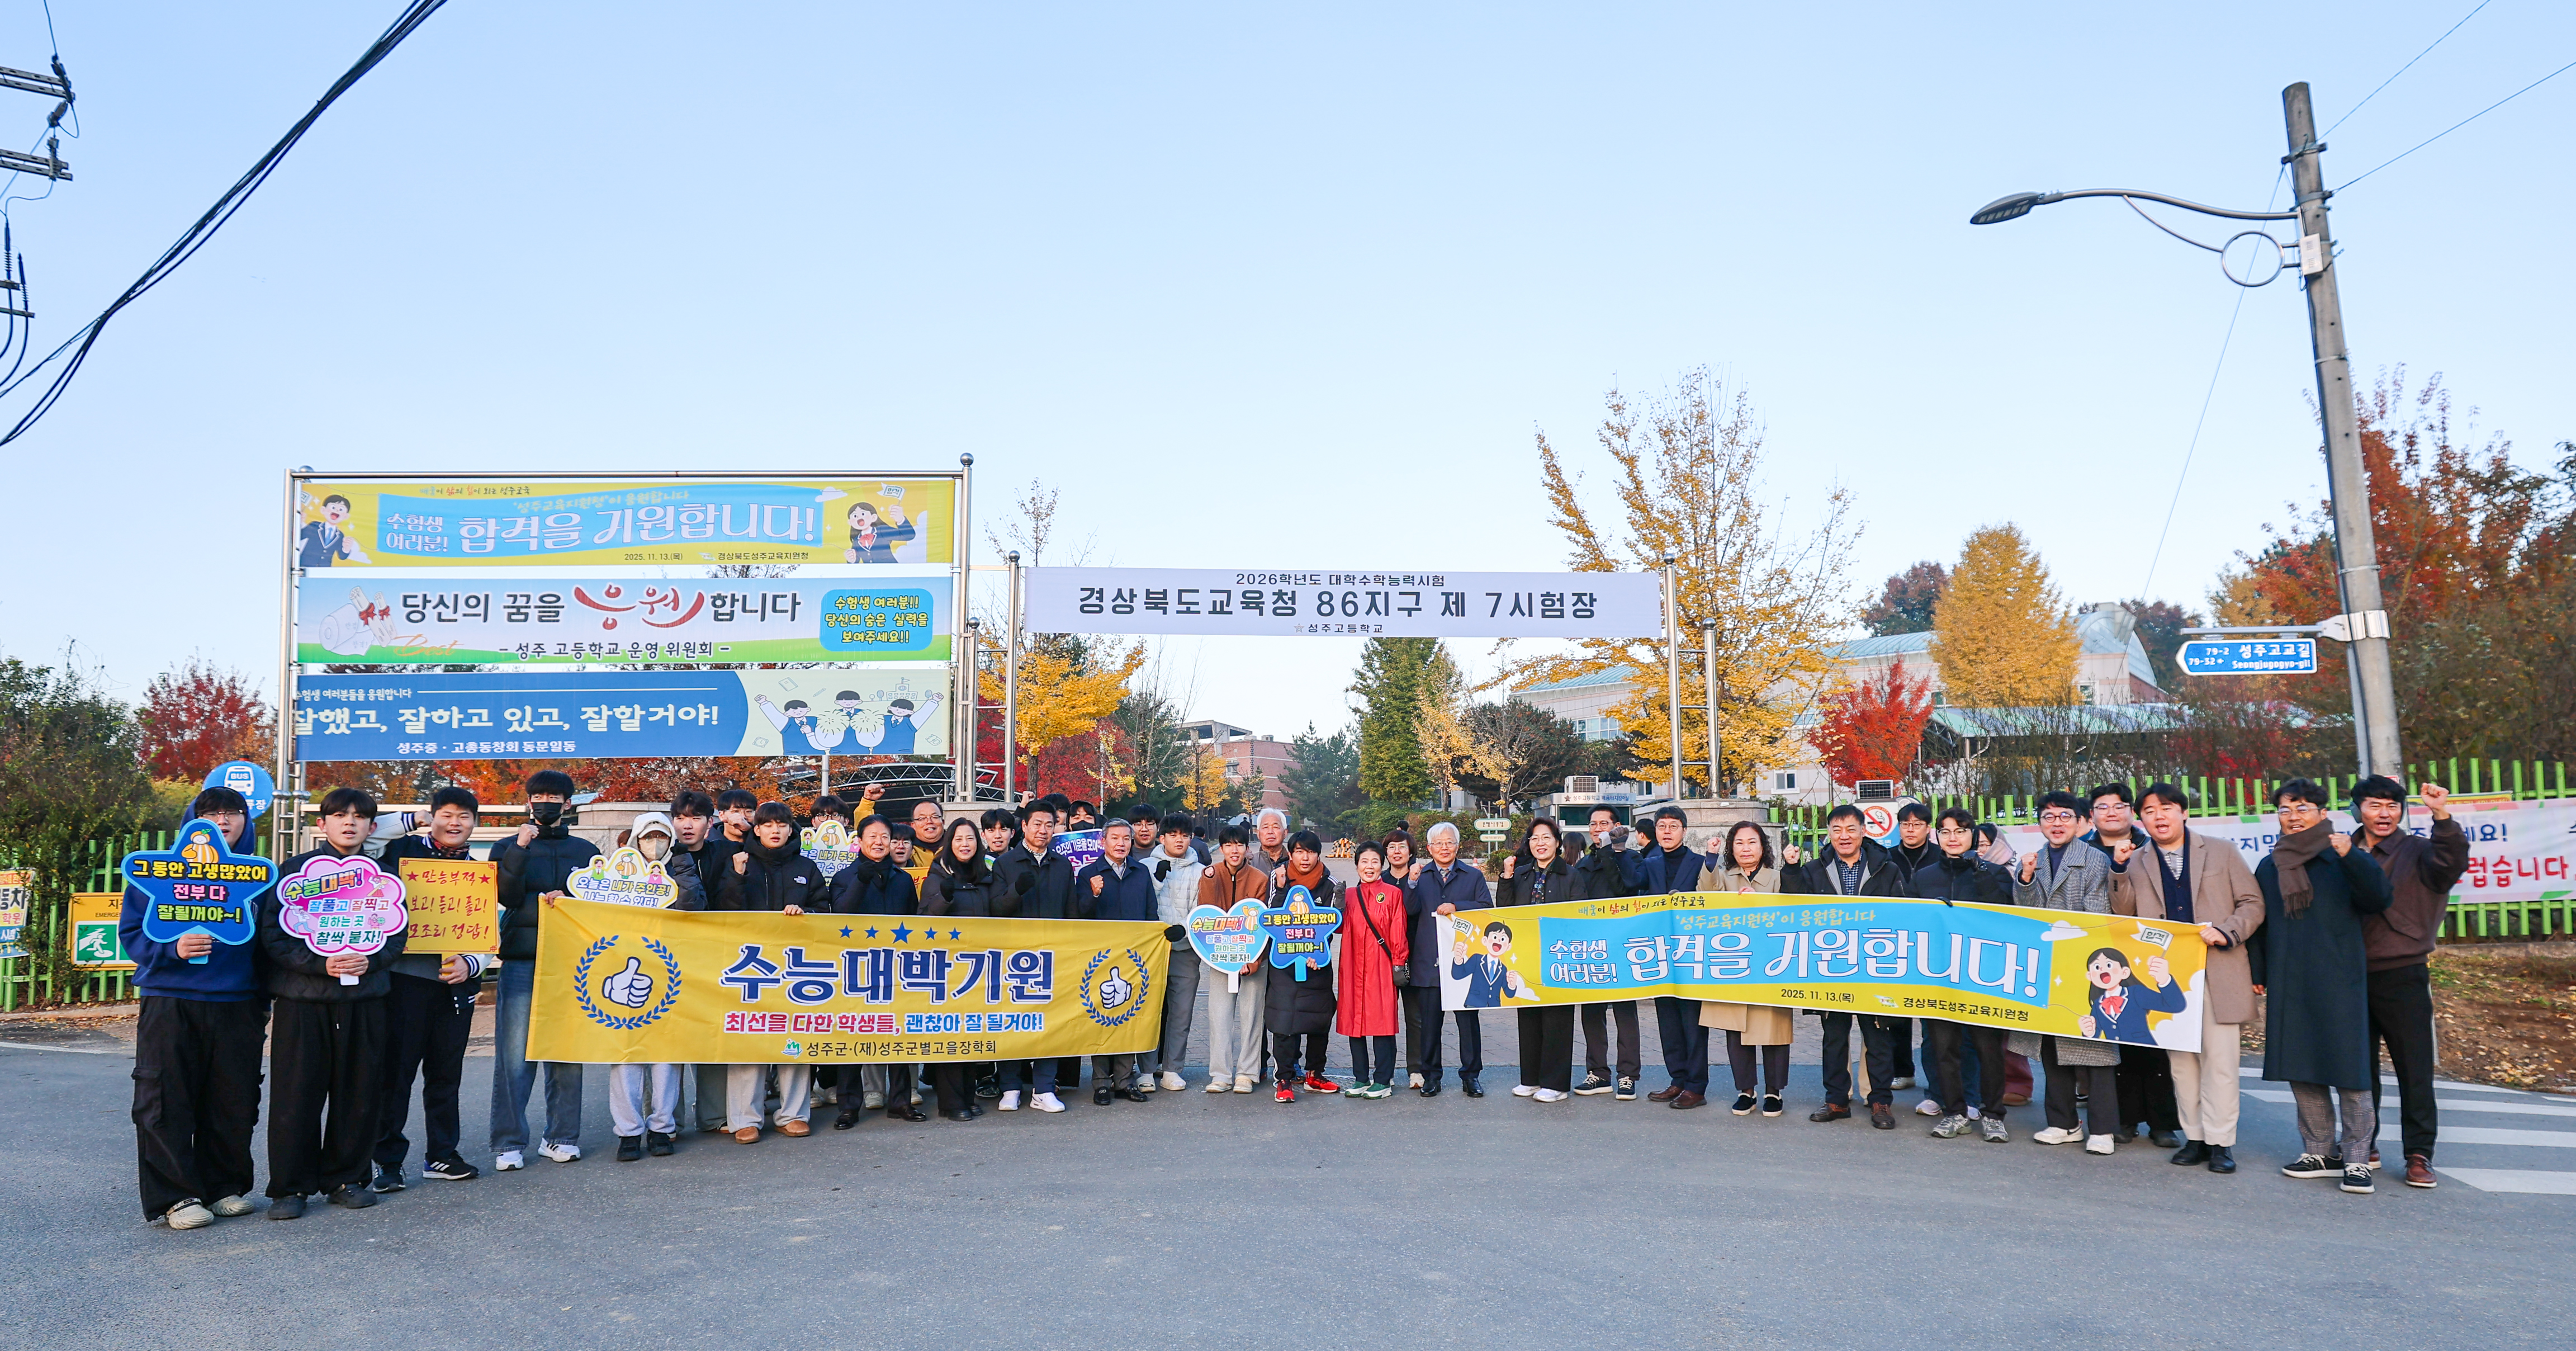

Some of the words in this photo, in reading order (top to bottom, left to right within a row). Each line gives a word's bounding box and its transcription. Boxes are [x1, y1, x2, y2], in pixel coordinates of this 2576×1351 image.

[500, 485, 531, 495] 성주교육
[887, 487, 900, 495] 합격
[625, 490, 689, 506] 응원합니다
[386, 513, 443, 533] 수험생
[457, 512, 584, 553] 합격을
[593, 502, 815, 545] 기원합니다!
[385, 532, 448, 552] 여러분!
[659, 553, 683, 561] 13.(목)
[717, 551, 808, 560] 경상북도성주교육지원청
[1235, 573, 1322, 586] 2026학년도
[1329, 574, 1445, 587] 대학수학능력시험
[402, 593, 490, 623] 당신의
[502, 593, 565, 623] 꿈을
[835, 596, 870, 610] 수험생
[873, 595, 919, 610] 여러분!!
[1079, 587, 1297, 617] 경상북도교육청
[1317, 591, 1422, 617] 86지구
[1441, 592, 1466, 617] 제
[825, 613, 861, 627] 당신의
[864, 613, 886, 627] 숨은
[893, 612, 928, 627] 실력을
[1308, 623, 1384, 634] 성주고등학교
[393, 634, 465, 656] Best
[841, 631, 910, 644] 보여주세요!!
[515, 643, 546, 659] 성주
[553, 642, 621, 659] 고등학교
[628, 642, 659, 658] 운영
[666, 641, 713, 658] 위원회
[2206, 647, 2230, 656] 79-2
[2239, 643, 2311, 659] 성주고교길
[2231, 659, 2311, 670] Seongjugogyo-gil
[322, 688, 366, 701] 여러분들을
[367, 688, 411, 701] 응원합니다
[295, 707, 388, 735] 잘했고,
[396, 706, 493, 734] 잘하고
[504, 705, 570, 733] 있고,
[579, 703, 718, 732] 잘할거야!
[396, 742, 438, 754] 성주중
[451, 741, 519, 754] 고총동창회
[522, 740, 576, 753] 동문일동
[247, 799, 267, 810] 류장
[819, 849, 837, 861] 내가
[839, 851, 859, 862] 주인
[133, 860, 149, 876] 그
[153, 861, 184, 877] 동안
[188, 862, 267, 881] 고생많았어
[284, 867, 363, 901] 수능대박!
[422, 871, 476, 886] 만능부적
[576, 876, 610, 891] 오늘은
[612, 880, 634, 892] 내가
[635, 882, 671, 896] 주인공!
[0, 887, 25, 910] 동차
[173, 884, 206, 900] 전부
[210, 885, 226, 901] 다
[308, 899, 348, 913] 잘풀고
[352, 898, 389, 911] 잘찍고
[410, 897, 433, 913] 보고!
[1578, 904, 1606, 917] 배움이
[1609, 902, 1629, 914] 삶의
[1632, 899, 1650, 913] 힘이
[1670, 895, 1706, 909] 성주교육
[158, 905, 241, 923] 잘될꺼야~!
[319, 916, 352, 928] 원하는
[354, 915, 364, 927] 곳
[1263, 915, 1272, 925] 그
[1273, 915, 1291, 925] 동안
[1292, 913, 1337, 924] 고생많았어
[1799, 908, 1876, 927] 응원합니다
[1191, 917, 1244, 932] 수능대박!
[1455, 920, 1470, 932] 합격
[316, 932, 347, 946] 찰싹
[350, 930, 381, 944] 붙자!
[408, 924, 446, 939] 모조리
[451, 925, 489, 941] 정답!
[1206, 934, 1230, 943] 잘풀고
[1232, 935, 1254, 943] 잘찍고
[1286, 928, 1304, 938] 전부
[1305, 928, 1315, 938] 다
[2145, 928, 2166, 943] 합격
[1215, 944, 1237, 953] 원하는
[1239, 944, 1246, 952] 곳
[1549, 938, 1608, 960] 수험생
[1211, 954, 1228, 962] 찰싹
[1230, 953, 1250, 962] 붙자!
[1623, 932, 1753, 982] 합격을
[1764, 928, 2040, 998] 기원합니다!
[719, 944, 1054, 1005] 수능대박기원
[1549, 962, 1618, 984] 여러분!
[1781, 989, 1807, 1000] 2025.
[1810, 990, 1823, 1001] 11.
[1825, 991, 1854, 1004] 13.(목)
[1903, 996, 2029, 1022] 경상북도성주교육지원청
[725, 1012, 788, 1033] 최선을
[793, 1013, 833, 1033] 다한
[837, 1013, 901, 1036] 학생들,
[906, 1013, 960, 1033] 괜찮아
[965, 1013, 982, 1032] 잘
[987, 1012, 1044, 1032] 될거야!
